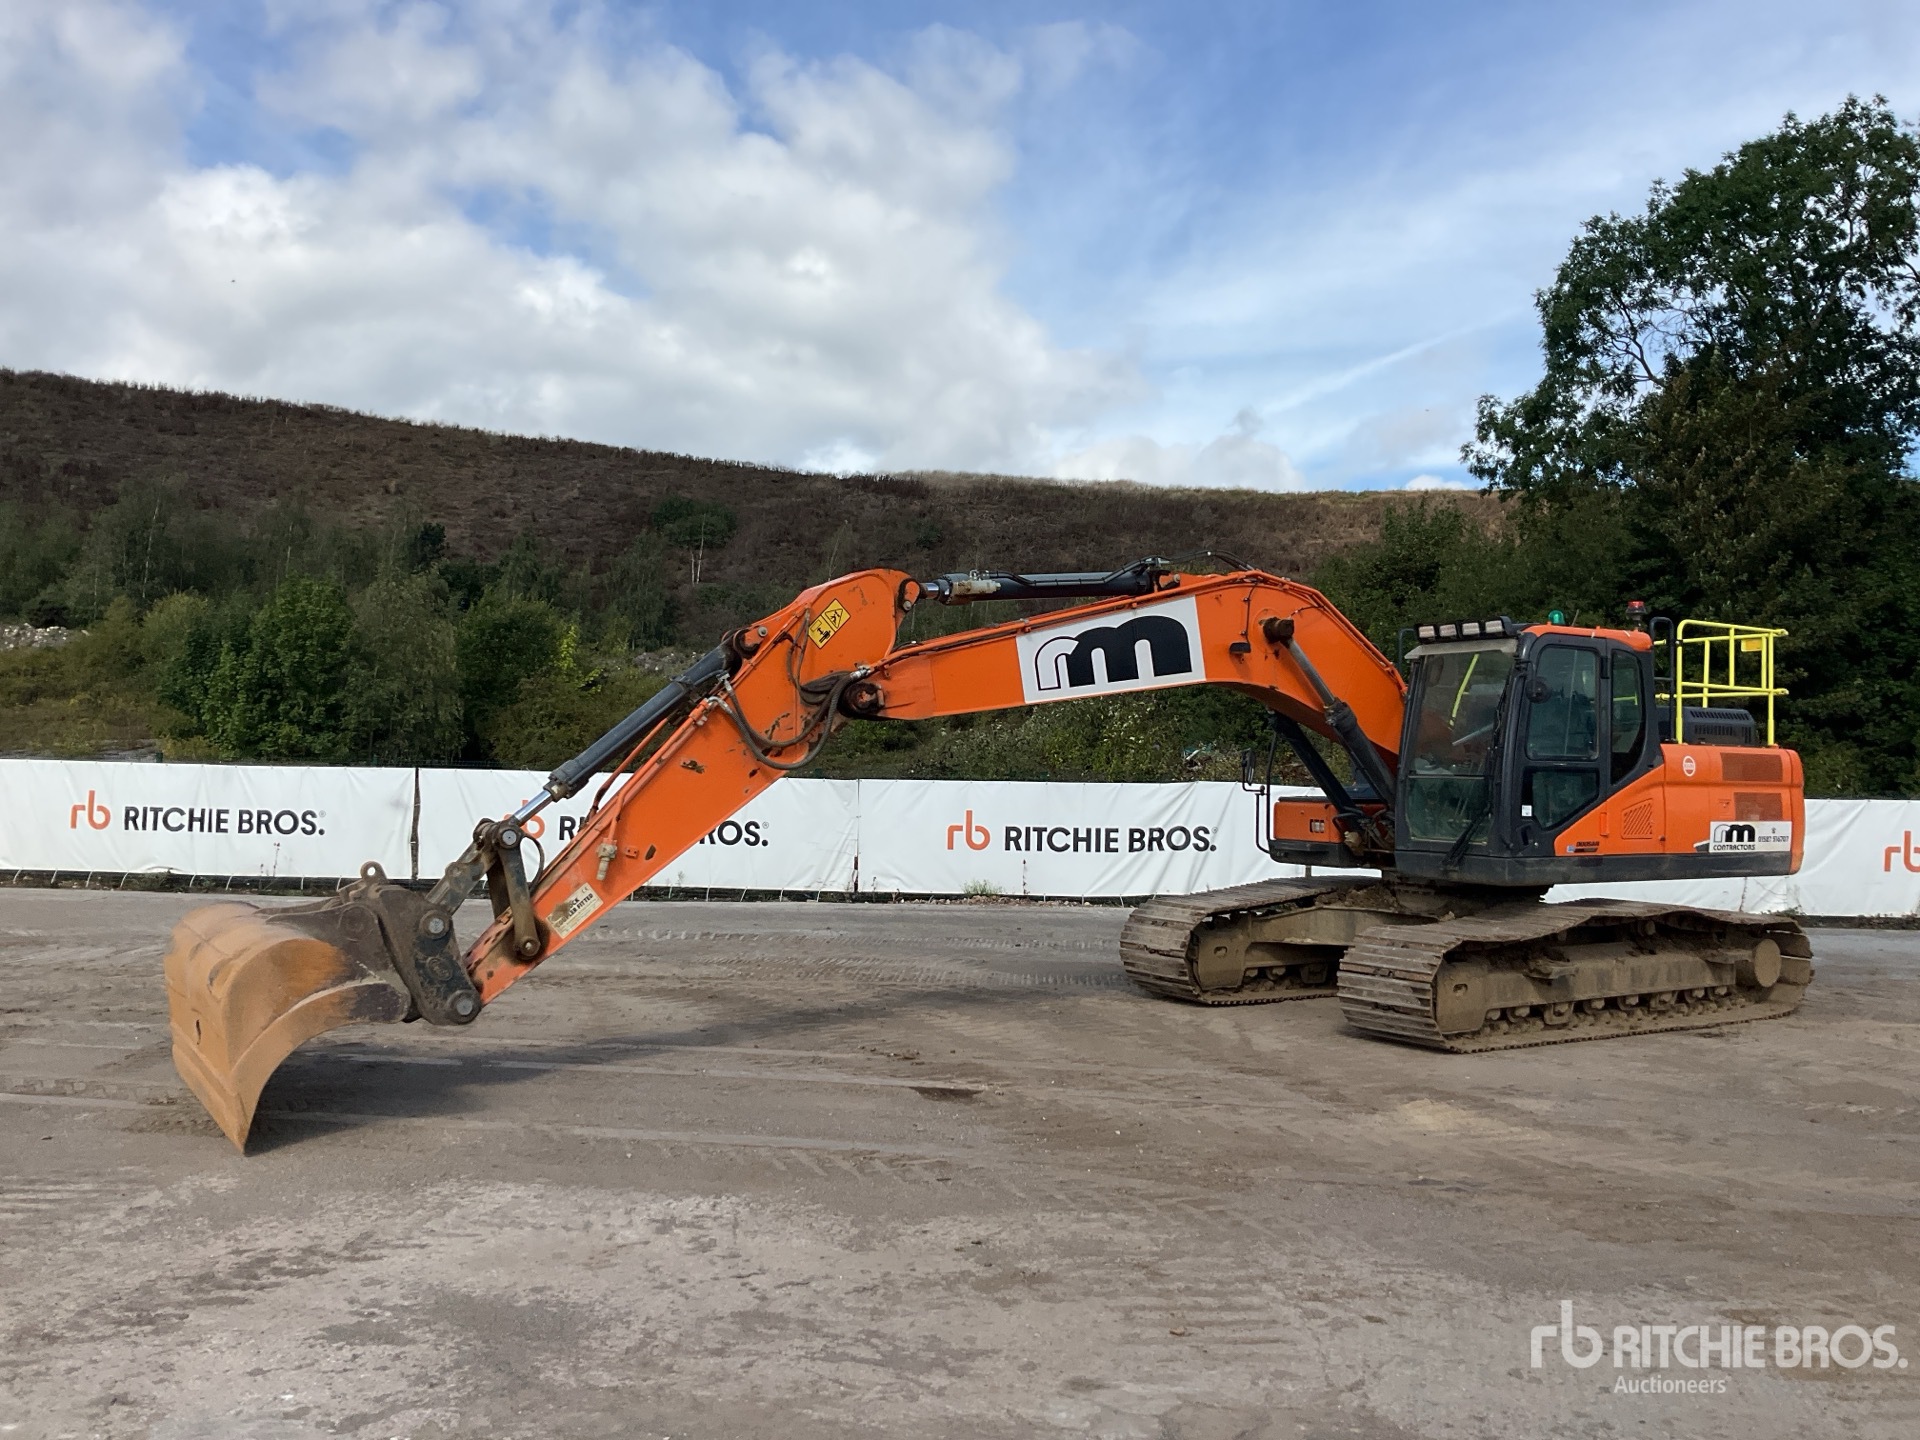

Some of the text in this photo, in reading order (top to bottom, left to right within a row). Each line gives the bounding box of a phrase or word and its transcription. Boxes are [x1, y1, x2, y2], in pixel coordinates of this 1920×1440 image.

[70, 790, 326, 836] rb RITCHIE BROS.
[947, 810, 1217, 853] rb RITCHIE BROS.
